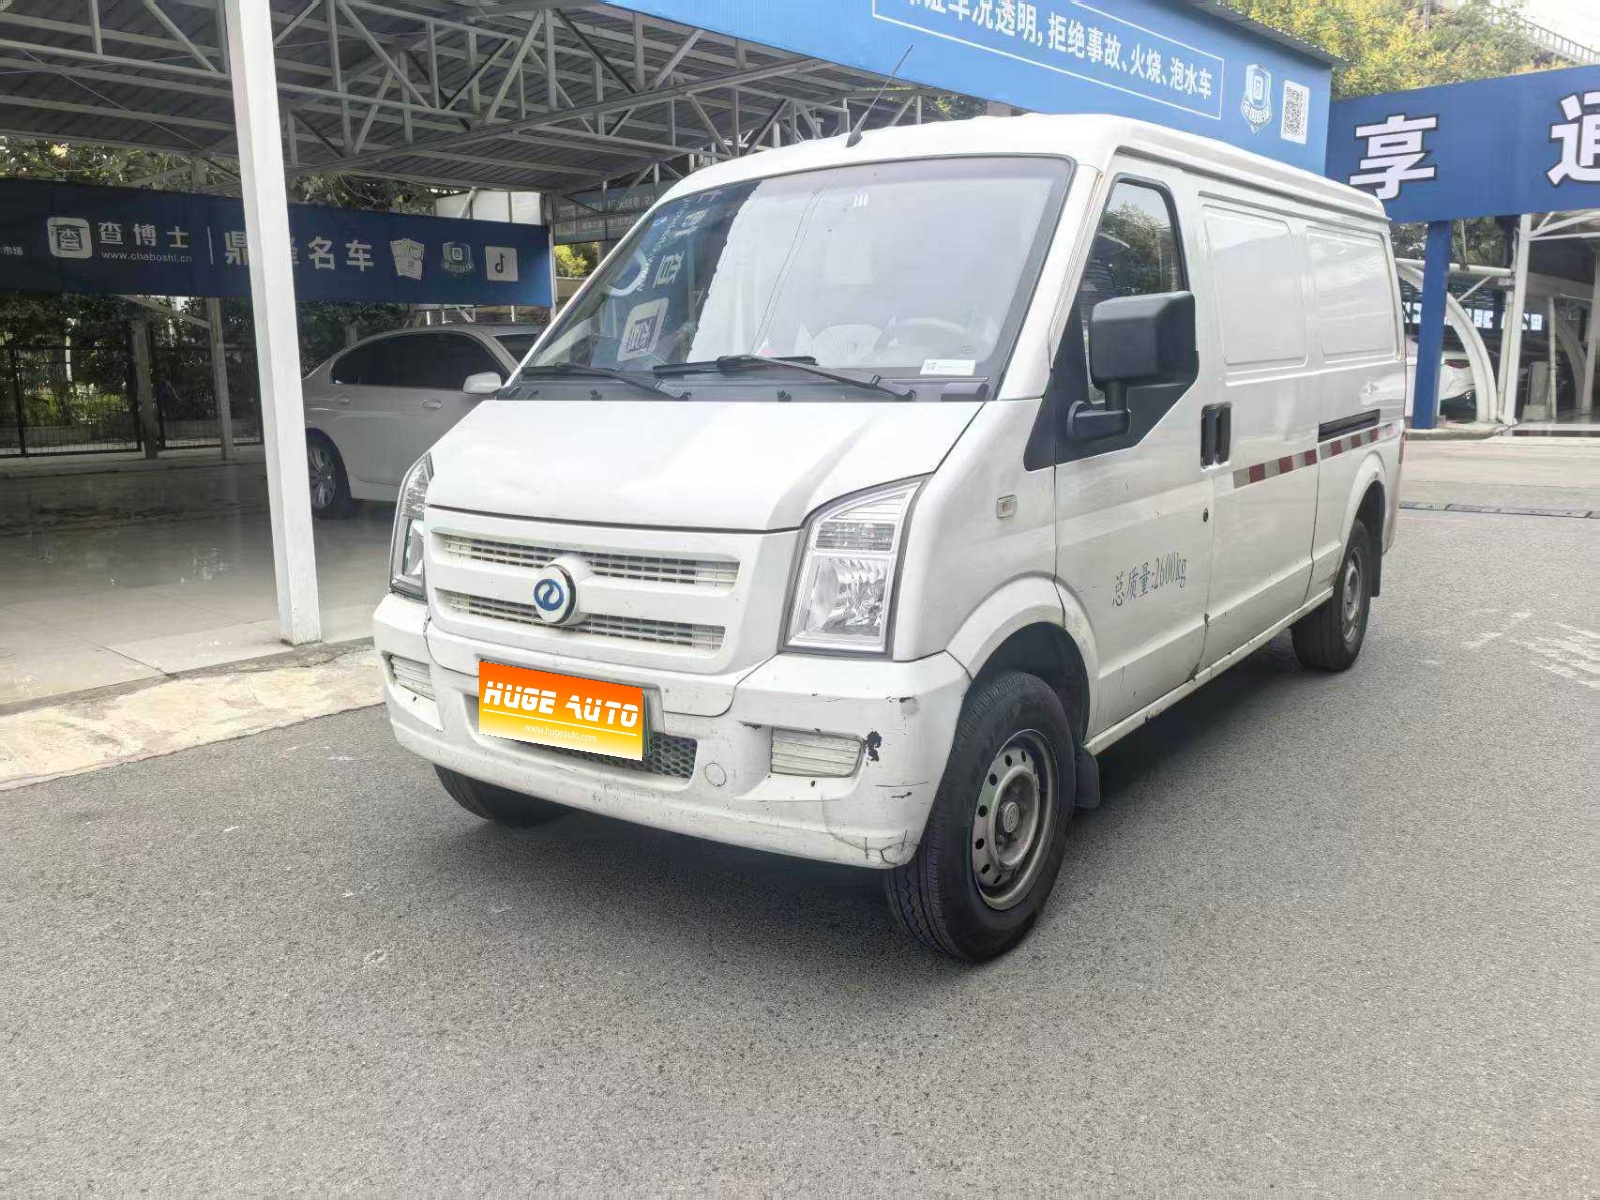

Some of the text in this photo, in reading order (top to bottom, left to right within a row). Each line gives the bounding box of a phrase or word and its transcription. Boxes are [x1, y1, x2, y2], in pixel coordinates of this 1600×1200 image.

[909, 0, 1212, 100] 车况透明，拒绝事故、火烧、泡水车
[98, 222, 375, 272] 查博士 鼎名车
[101, 251, 192, 263] www.chaboshi.cn
